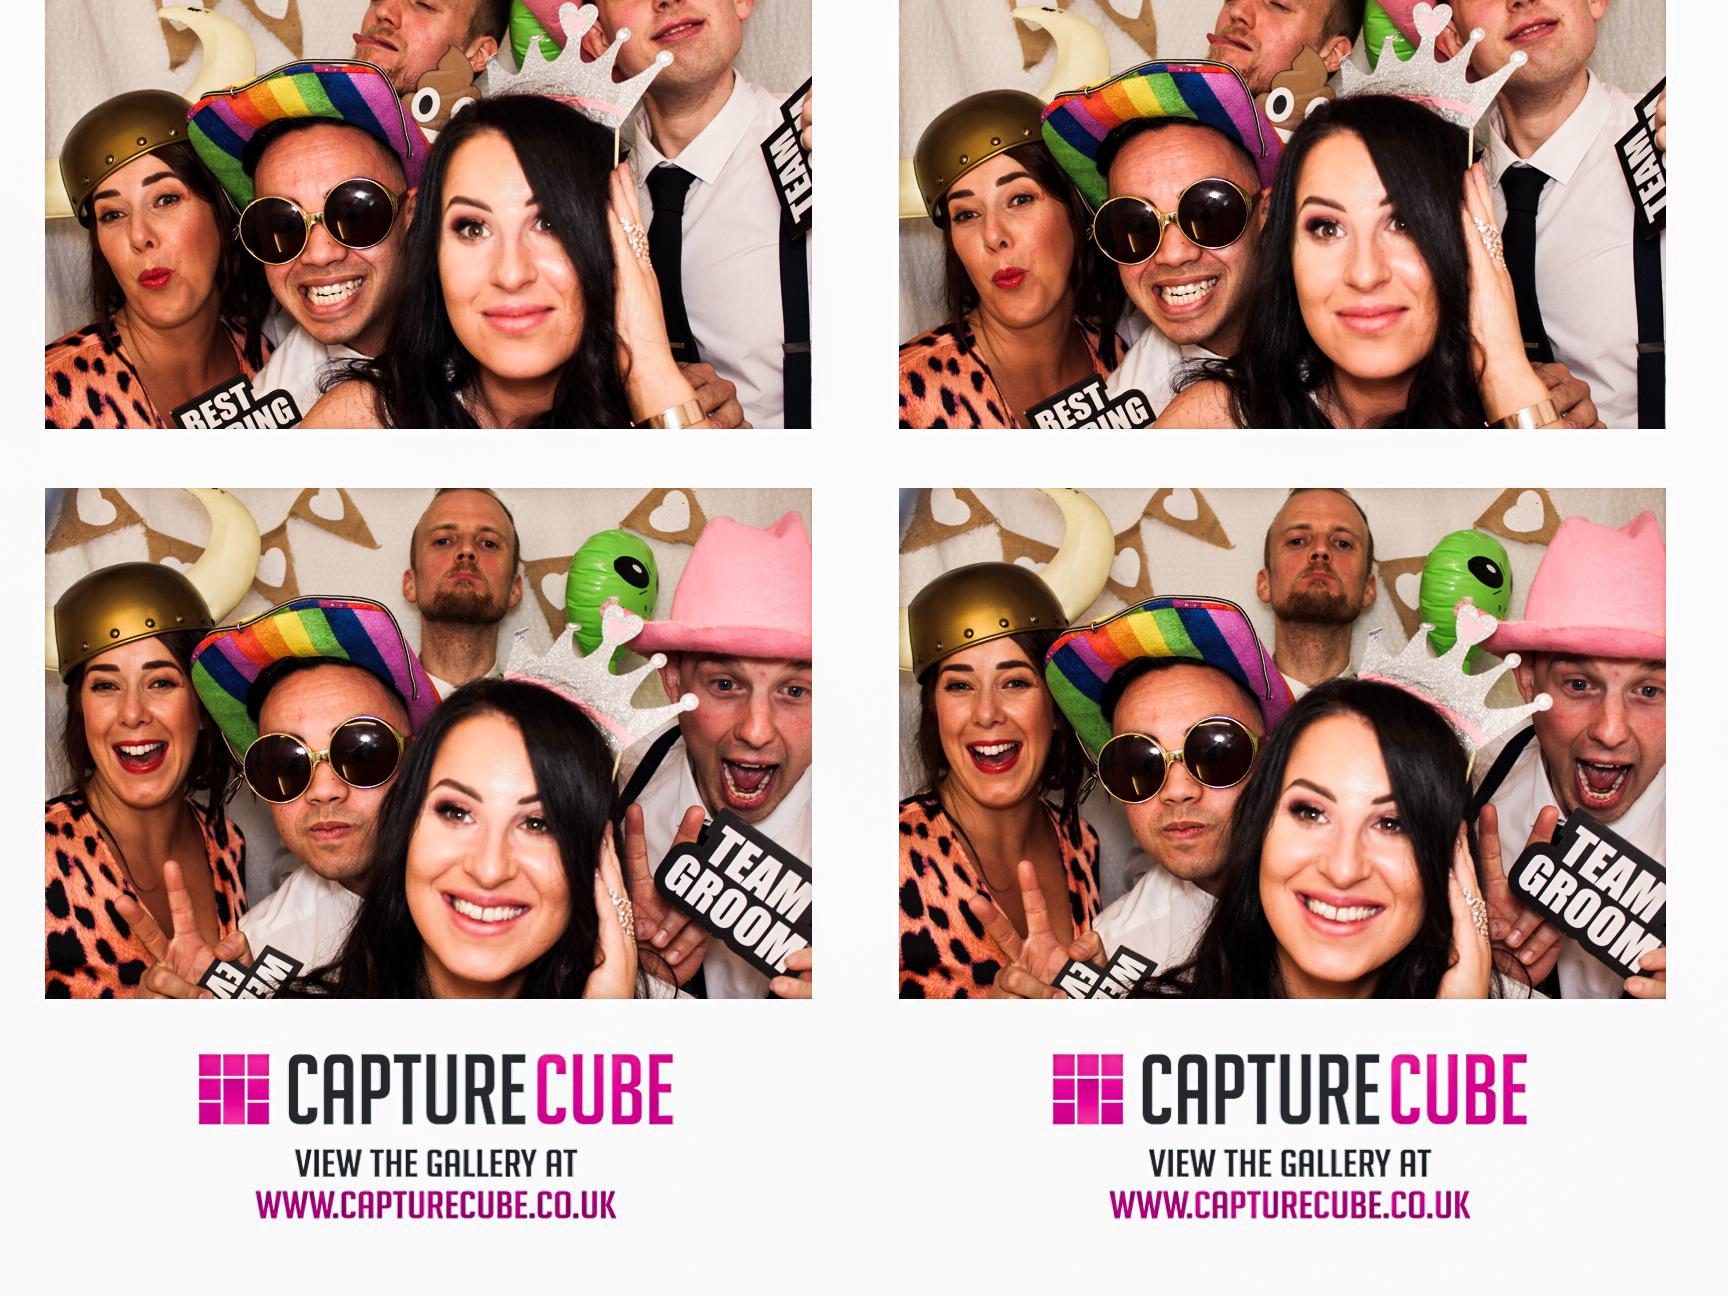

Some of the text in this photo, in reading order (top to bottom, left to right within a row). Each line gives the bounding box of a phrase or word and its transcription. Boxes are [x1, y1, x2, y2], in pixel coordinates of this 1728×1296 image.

[769, 127, 812, 224] TEAM
[1623, 127, 1666, 224] TEAM
[180, 382, 251, 429] BEST
[1034, 382, 1105, 429] BEST
[664, 854, 808, 974] GROOM
[708, 825, 812, 924] TEAM
[1518, 854, 1662, 974] GROOM
[1562, 825, 1666, 924] TEAM
